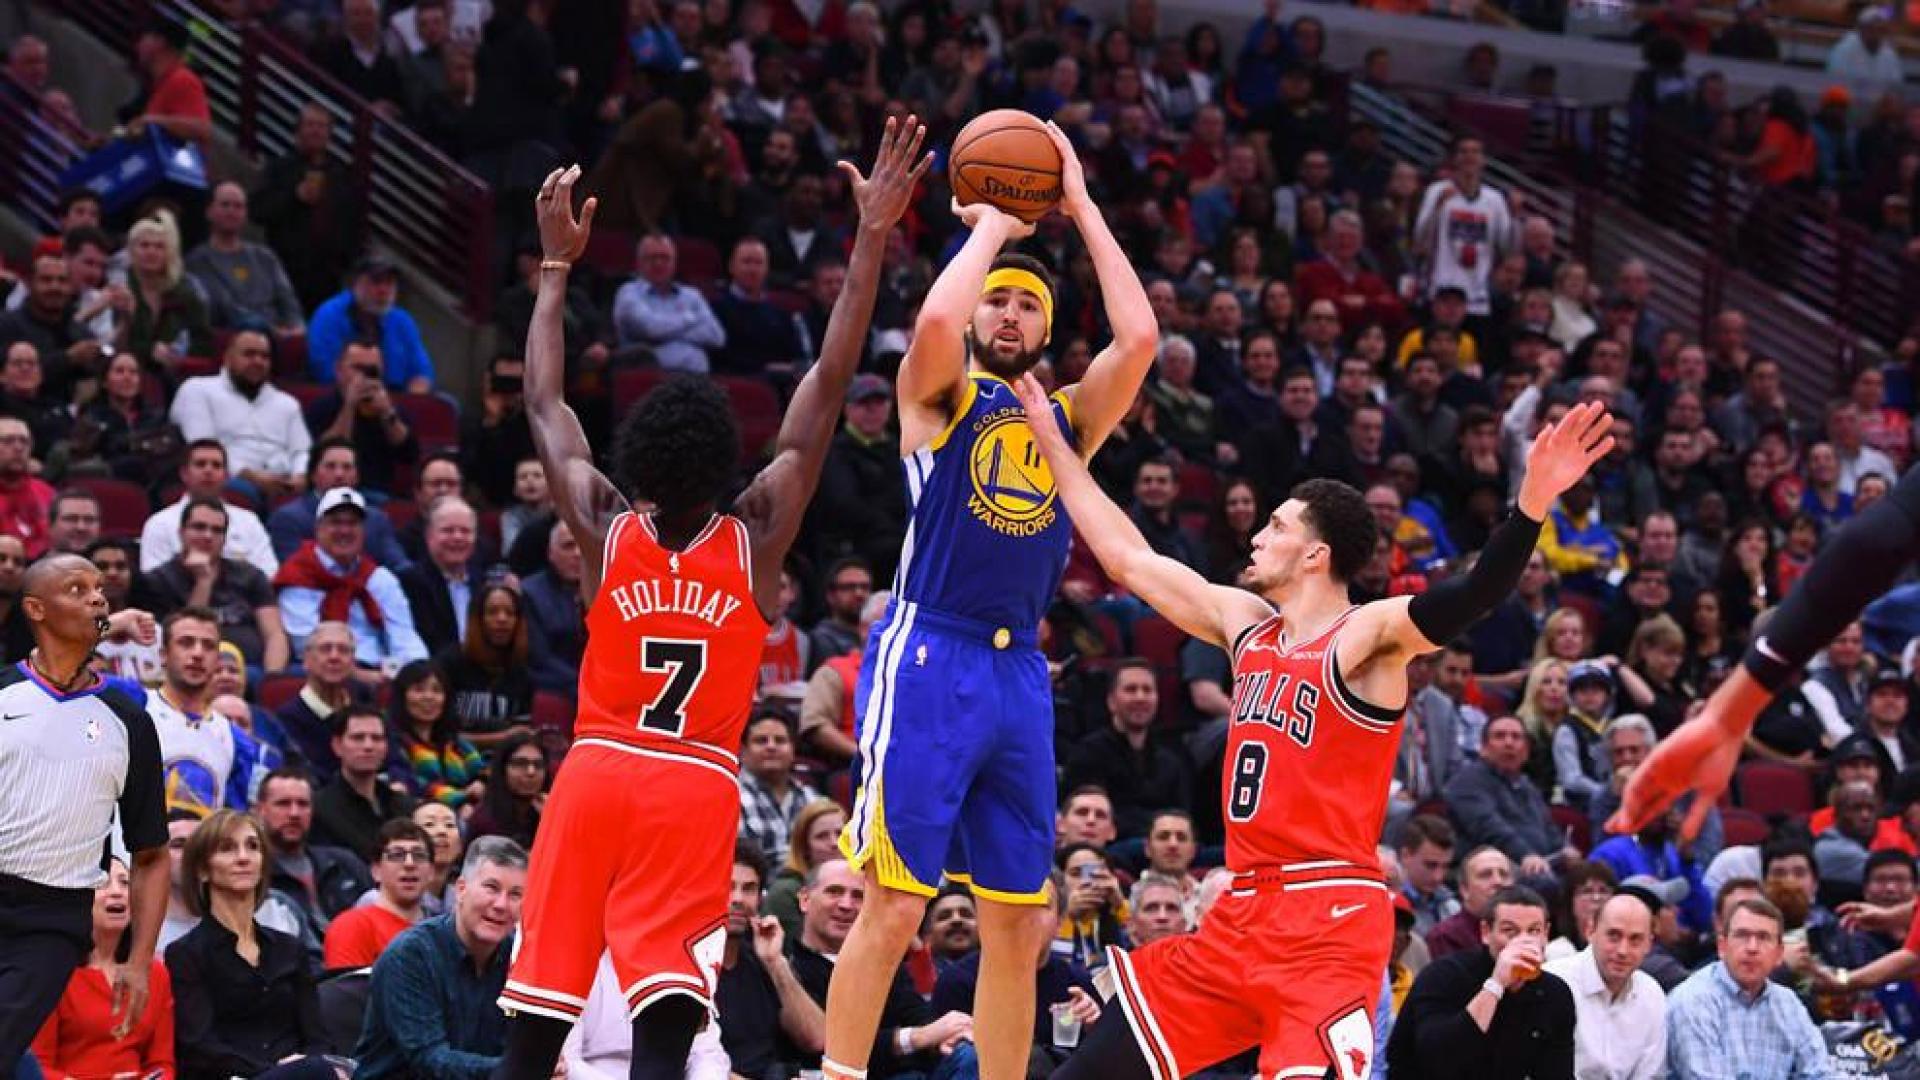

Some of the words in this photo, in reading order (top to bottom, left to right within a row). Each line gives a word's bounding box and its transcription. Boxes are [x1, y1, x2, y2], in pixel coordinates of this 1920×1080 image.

[968, 493, 1056, 537] WARRIORS
[611, 579, 742, 627] HOLIDAY
[637, 636, 709, 738] 7
[1234, 668, 1321, 749] ULLS
[1228, 740, 1269, 822] 8
